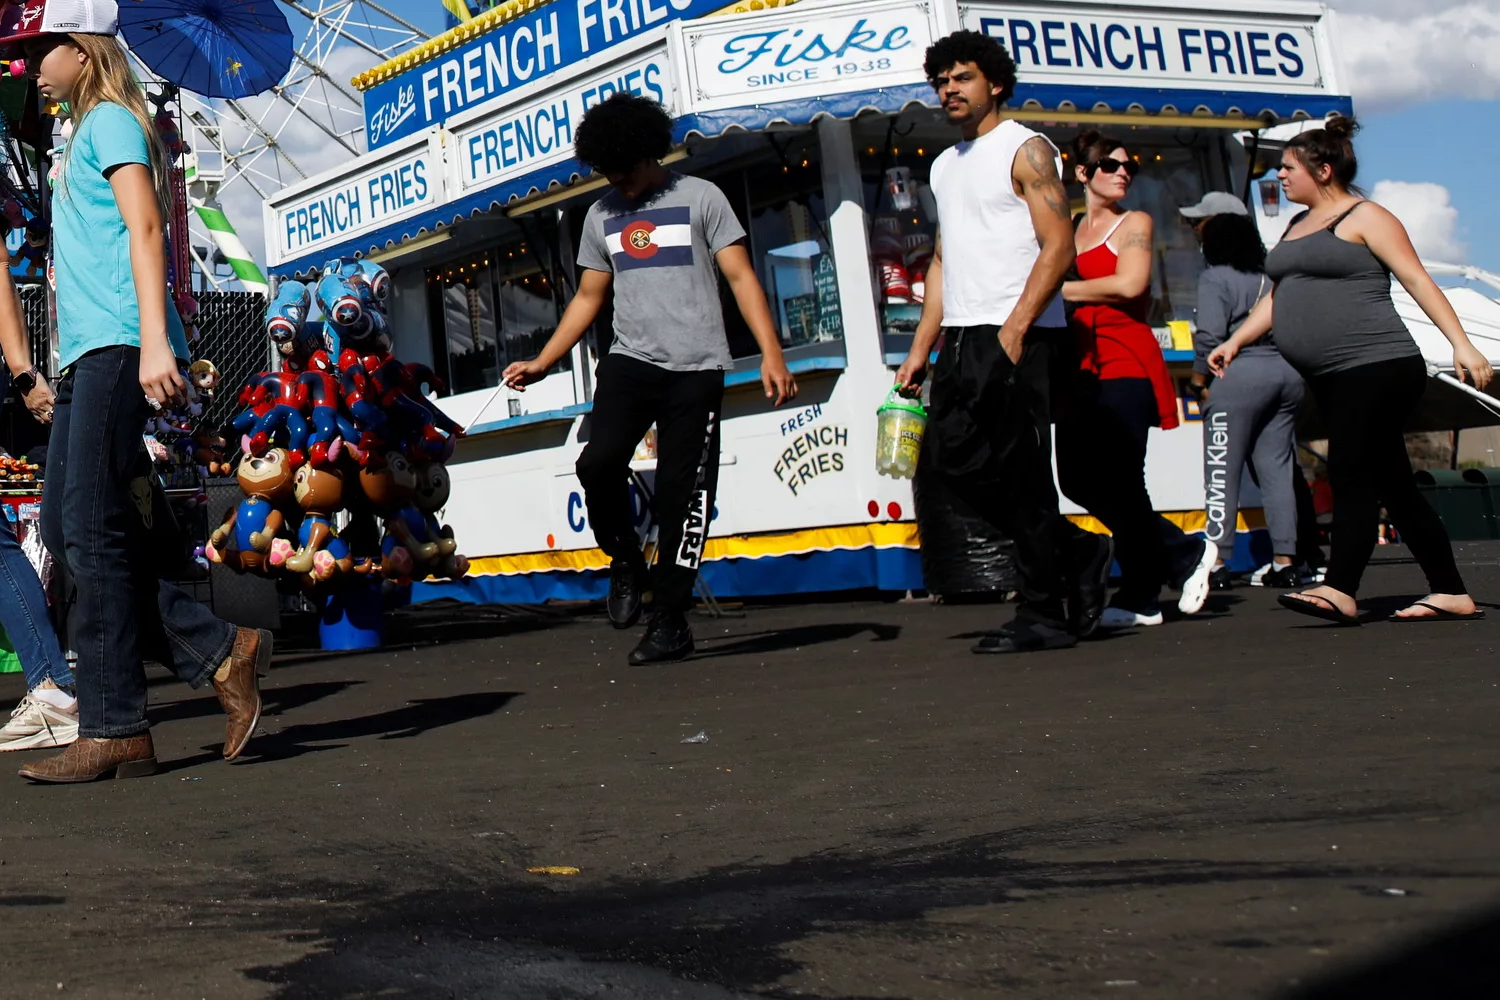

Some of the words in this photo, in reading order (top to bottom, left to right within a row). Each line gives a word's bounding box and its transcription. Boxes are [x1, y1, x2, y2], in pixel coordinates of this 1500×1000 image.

[717, 18, 912, 74] Fiske
[747, 67, 819, 87] SINCE
[832, 58, 891, 76] 1938
[979, 17, 1166, 71] FRENCH
[1177, 27, 1304, 78] FRIES
[370, 84, 415, 144] Fiske
[421, 15, 561, 122] FRENCH
[468, 100, 572, 180] FRENCH
[285, 185, 362, 250] FRENCH
[368, 159, 428, 219] FRIES
[780, 401, 822, 436] FRESH
[1206, 411, 1229, 466] Klein
[773, 426, 848, 482] FRENCH
[787, 452, 844, 497] FRIES
[1204, 469, 1227, 541] Calvin
